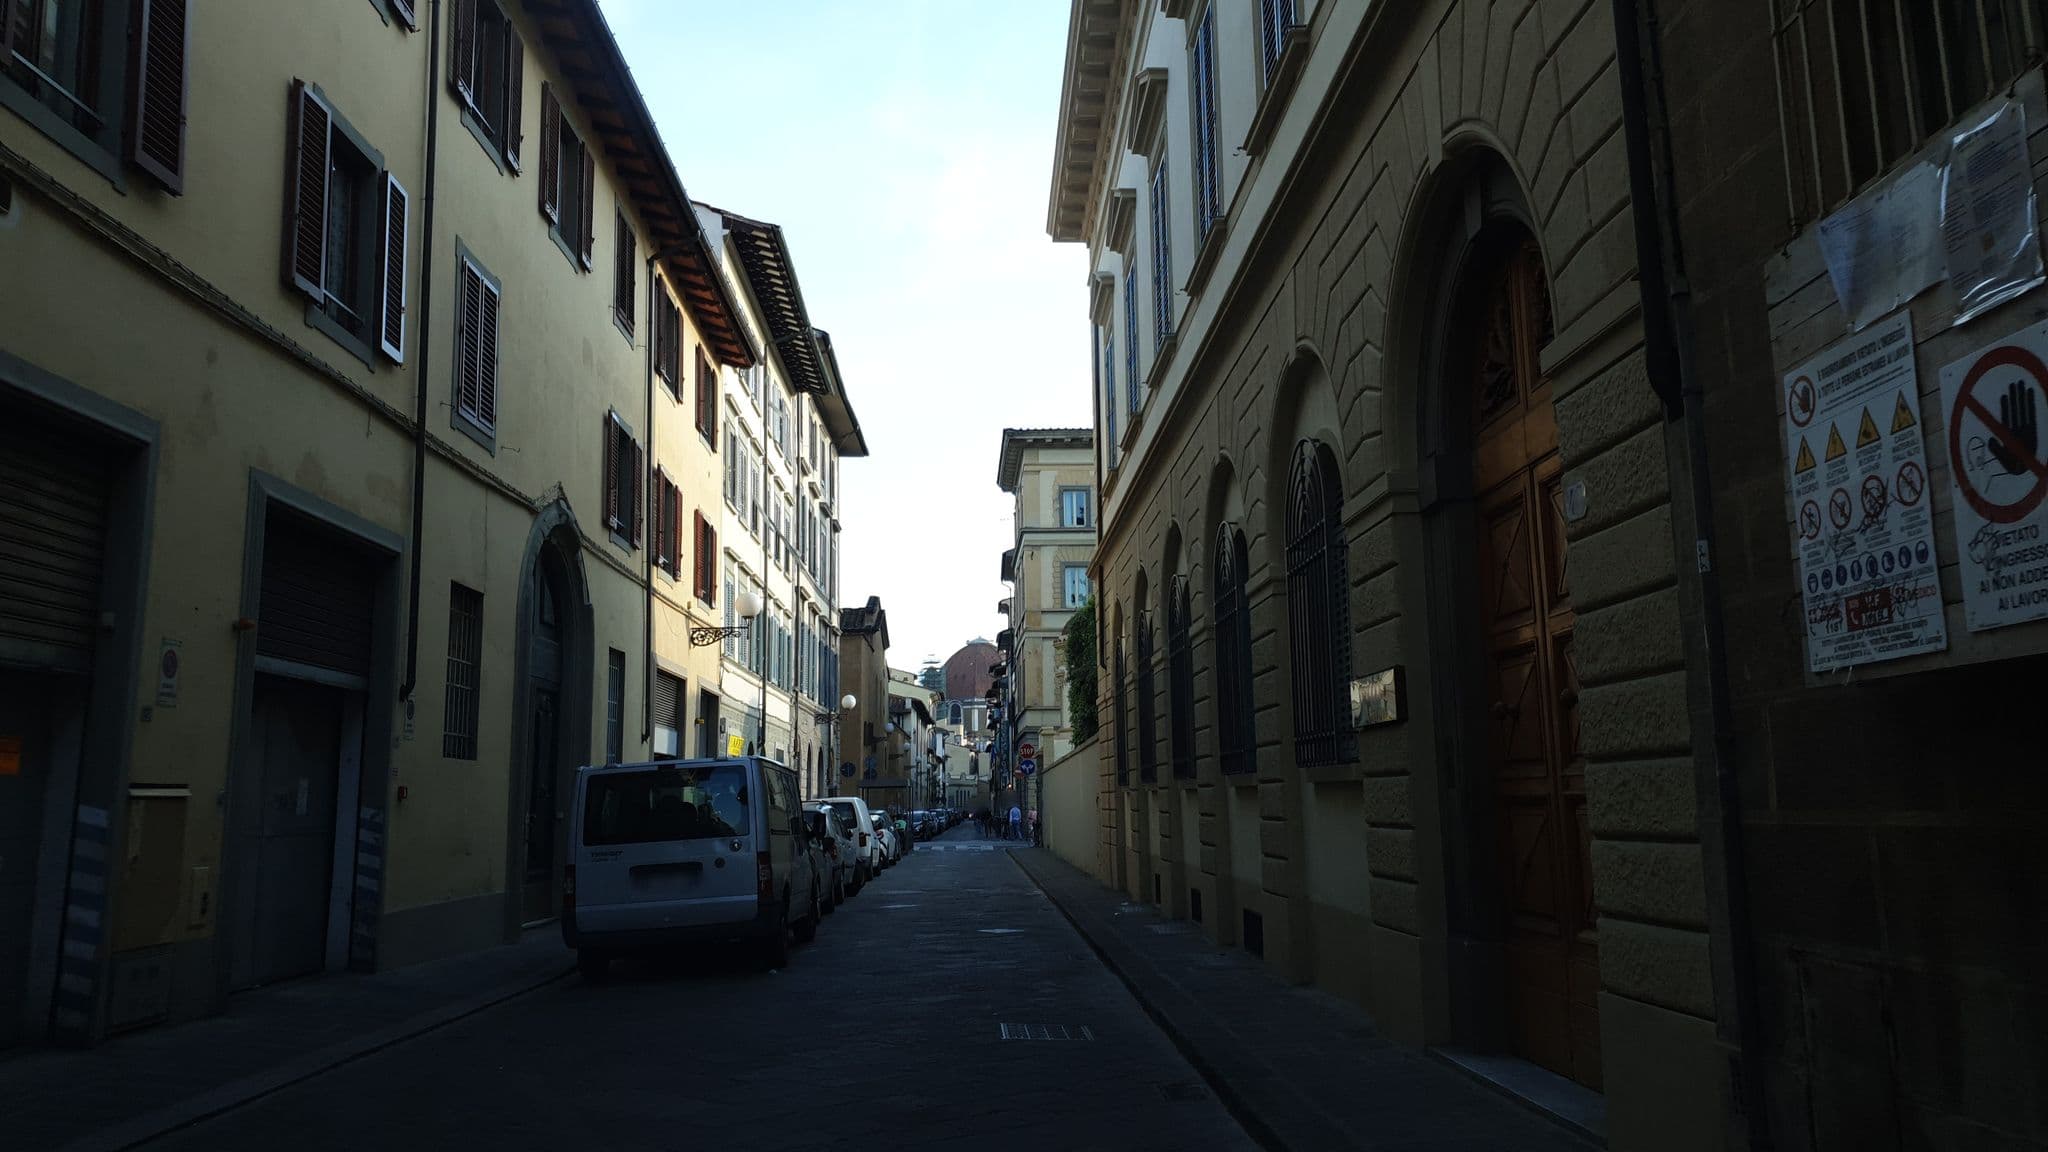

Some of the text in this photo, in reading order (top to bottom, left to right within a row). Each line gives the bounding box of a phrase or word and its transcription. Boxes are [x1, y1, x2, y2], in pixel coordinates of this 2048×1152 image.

[1980, 579, 1991, 592] AI
[1991, 573, 2018, 592] NON
[1999, 597, 2009, 610] AI
[1020, 748, 1034, 756] STOP
